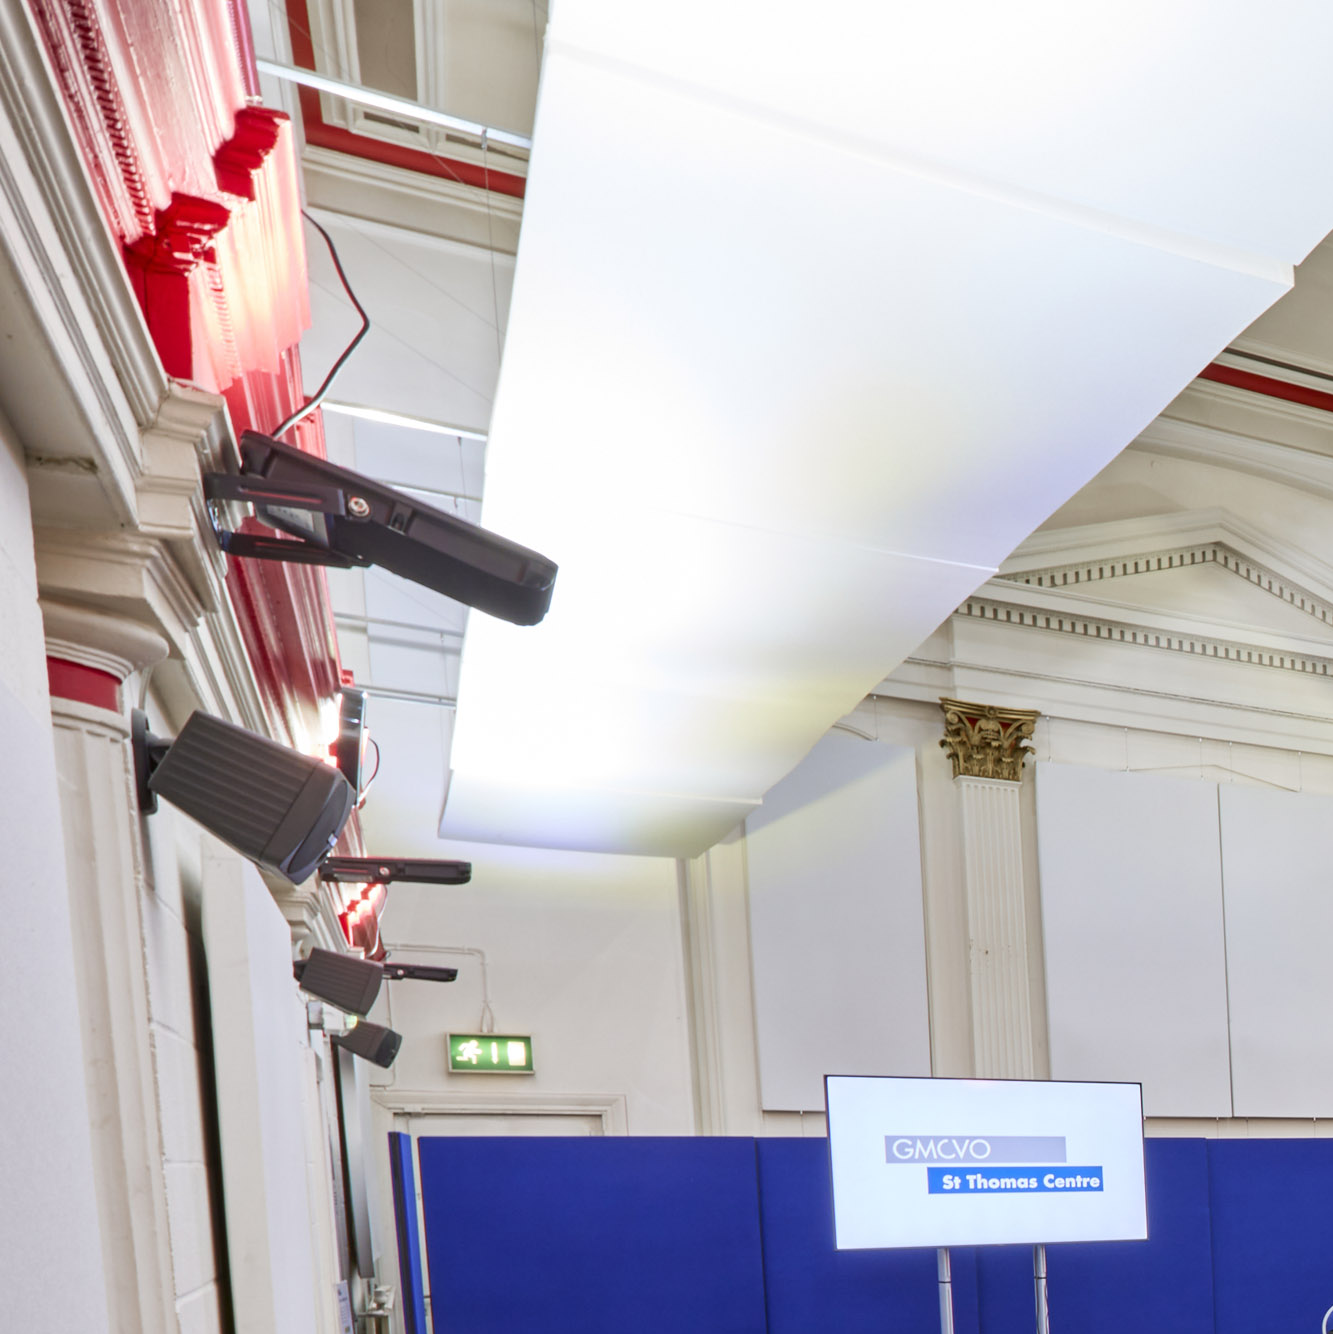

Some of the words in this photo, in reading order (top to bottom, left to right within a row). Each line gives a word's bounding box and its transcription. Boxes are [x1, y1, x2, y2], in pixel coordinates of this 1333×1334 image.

[892, 1138, 991, 1160] GMCVO
[942, 1174, 961, 1190] St
[966, 1173, 1038, 1190] Thomas
[1043, 1173, 1100, 1189] Centre
